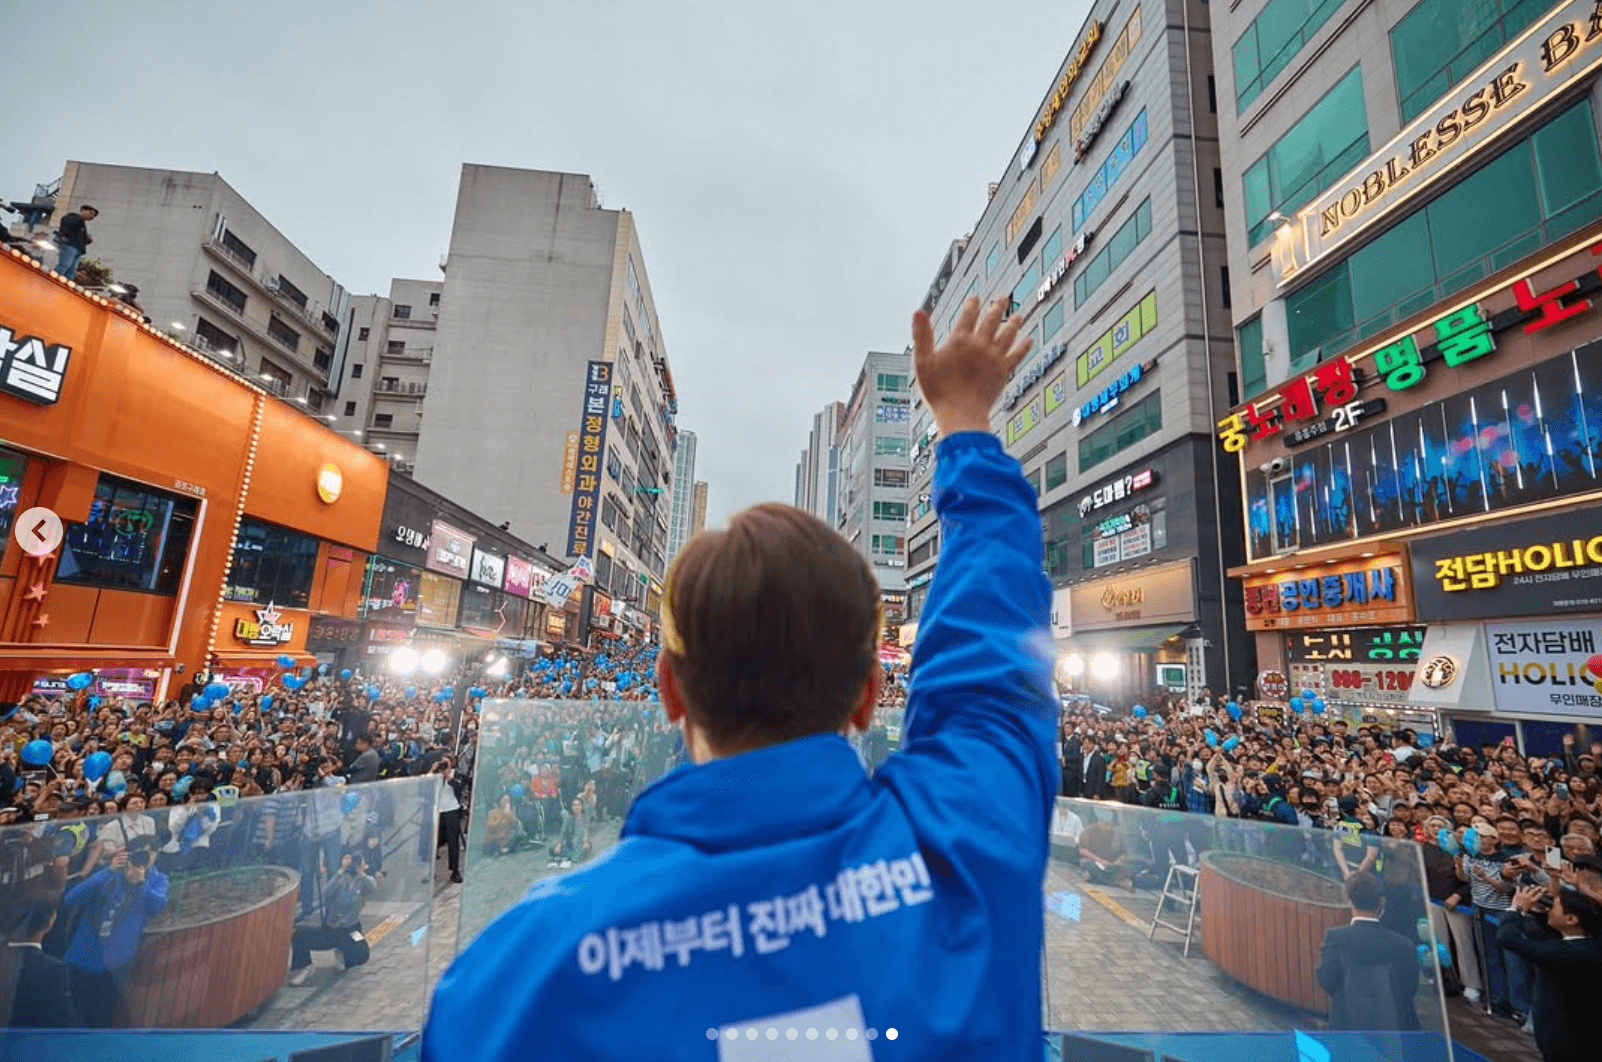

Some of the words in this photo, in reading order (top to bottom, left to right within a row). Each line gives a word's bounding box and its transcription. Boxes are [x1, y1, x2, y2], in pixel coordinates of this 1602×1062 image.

[1320, 62, 1527, 237] NOBLESSE
[1331, 399, 1365, 433] 2F
[1572, 567, 1602, 579] 무인매
[1493, 630, 1595, 655] 전자담배
[1550, 693, 1602, 708] 무인매장
[577, 903, 745, 982] 이제부터
[746, 883, 828, 956] 진짜
[824, 850, 934, 923] 대한민
